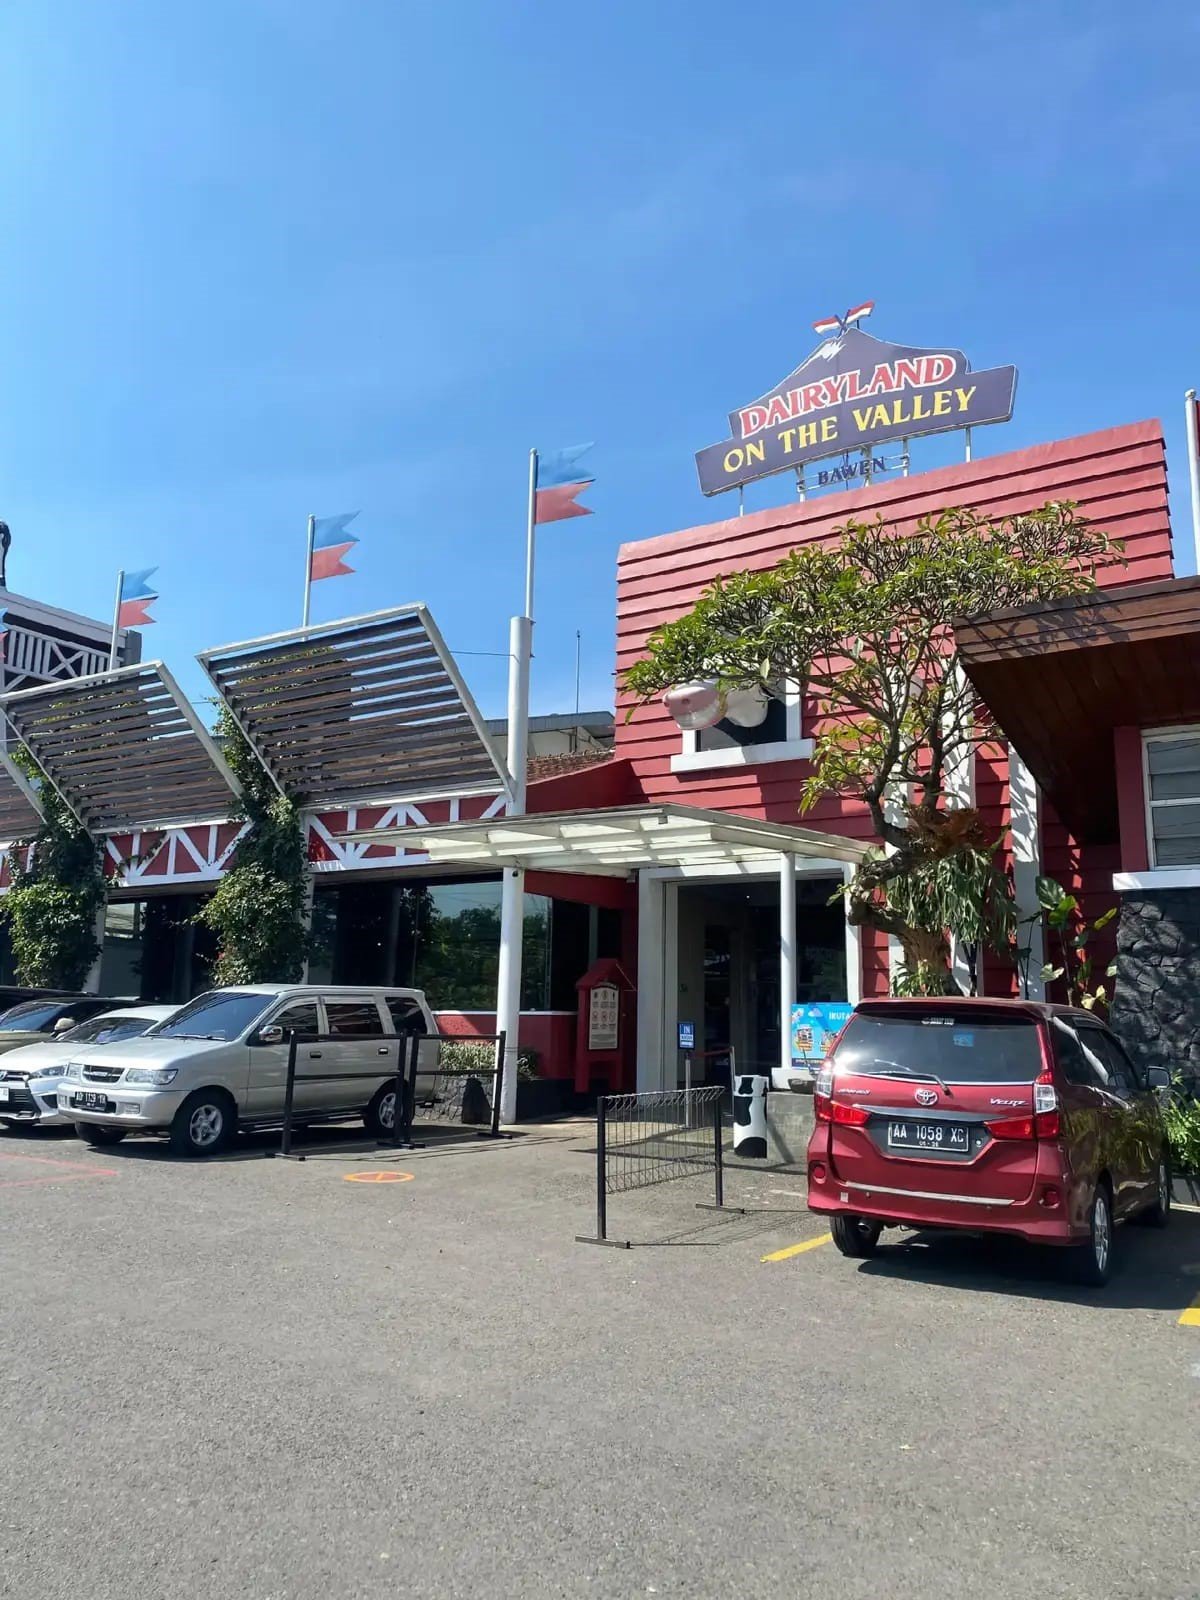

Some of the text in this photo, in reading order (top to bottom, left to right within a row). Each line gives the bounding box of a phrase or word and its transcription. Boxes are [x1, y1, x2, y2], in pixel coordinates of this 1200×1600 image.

[739, 354, 956, 439] DAIRYLAND
[723, 386, 977, 473] ON THE VALLEY
[818, 456, 887, 485] BAWEN
[893, 1124, 964, 1143] AA 1058 XC
